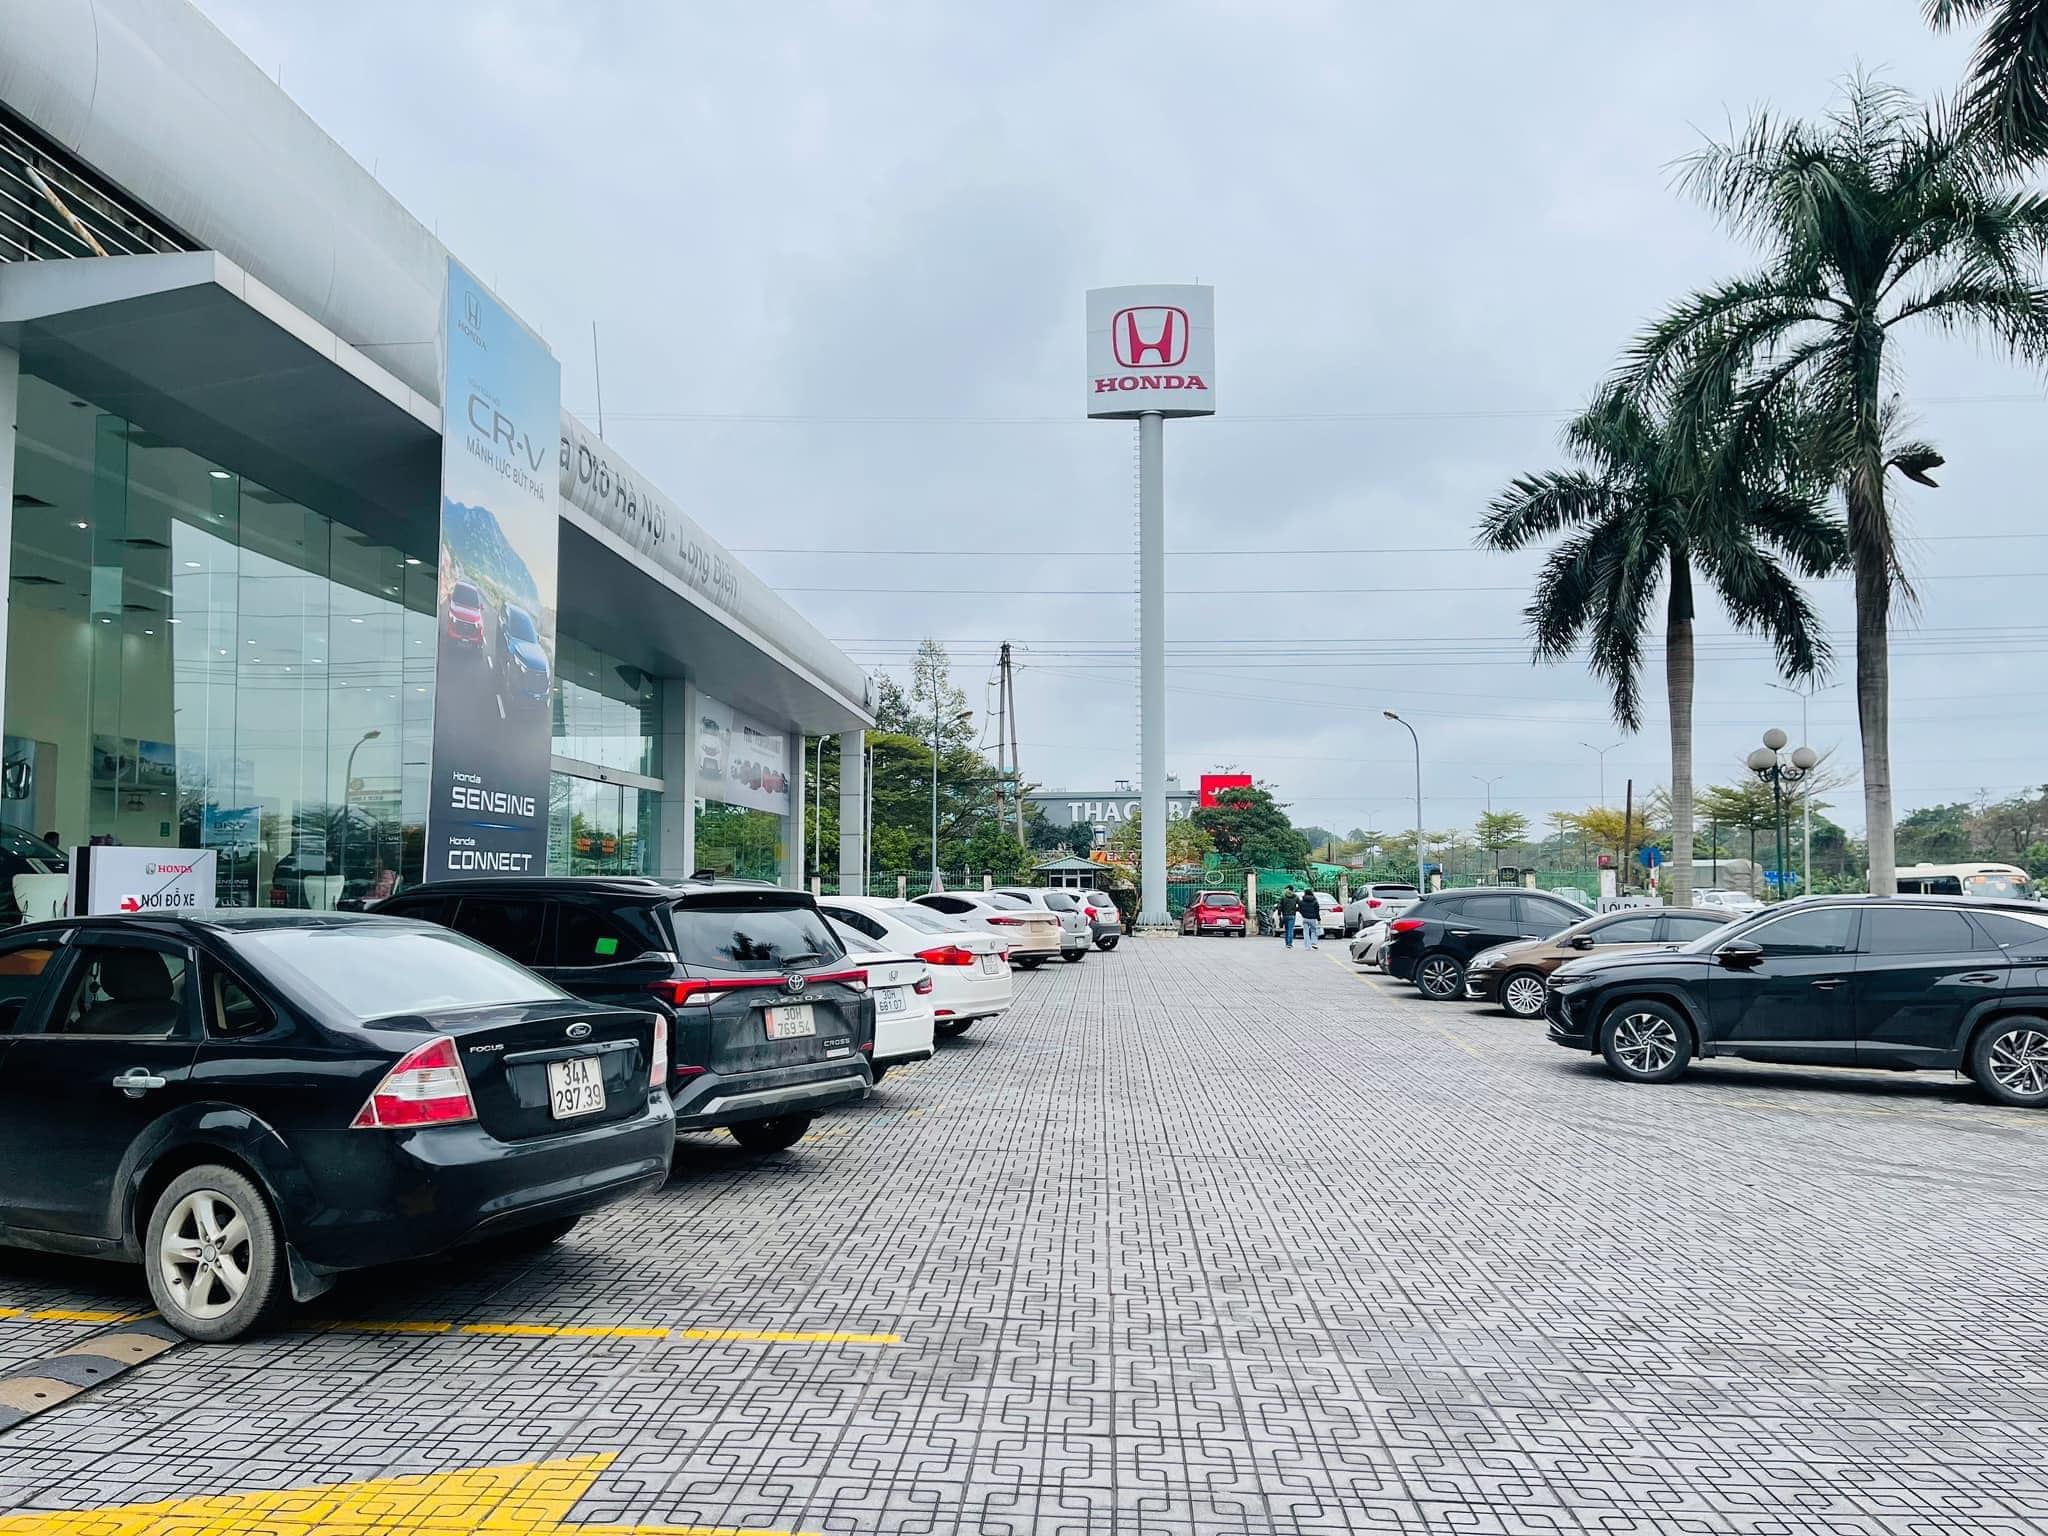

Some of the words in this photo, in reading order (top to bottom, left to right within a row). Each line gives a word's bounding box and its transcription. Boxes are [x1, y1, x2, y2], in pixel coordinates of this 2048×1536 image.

[457, 319, 488, 352] HONDA
[1095, 375, 1208, 393] HONDA
[467, 393, 545, 472] CR-V
[679, 524, 710, 585] Long
[452, 771, 481, 784] Honda
[451, 786, 536, 817] SENSING
[449, 837, 476, 846] Honda
[158, 864, 193, 873] HONDA
[447, 850, 533, 872] CONNECT
[183, 893, 195, 907] XE
[783, 1008, 803, 1021] 30H
[777, 1020, 812, 1037] 769.54
[469, 1043, 504, 1054] FOCUS
[823, 1038, 850, 1047] CROSS
[562, 1061, 590, 1086] 34A
[556, 1083, 601, 1113] 297.39
